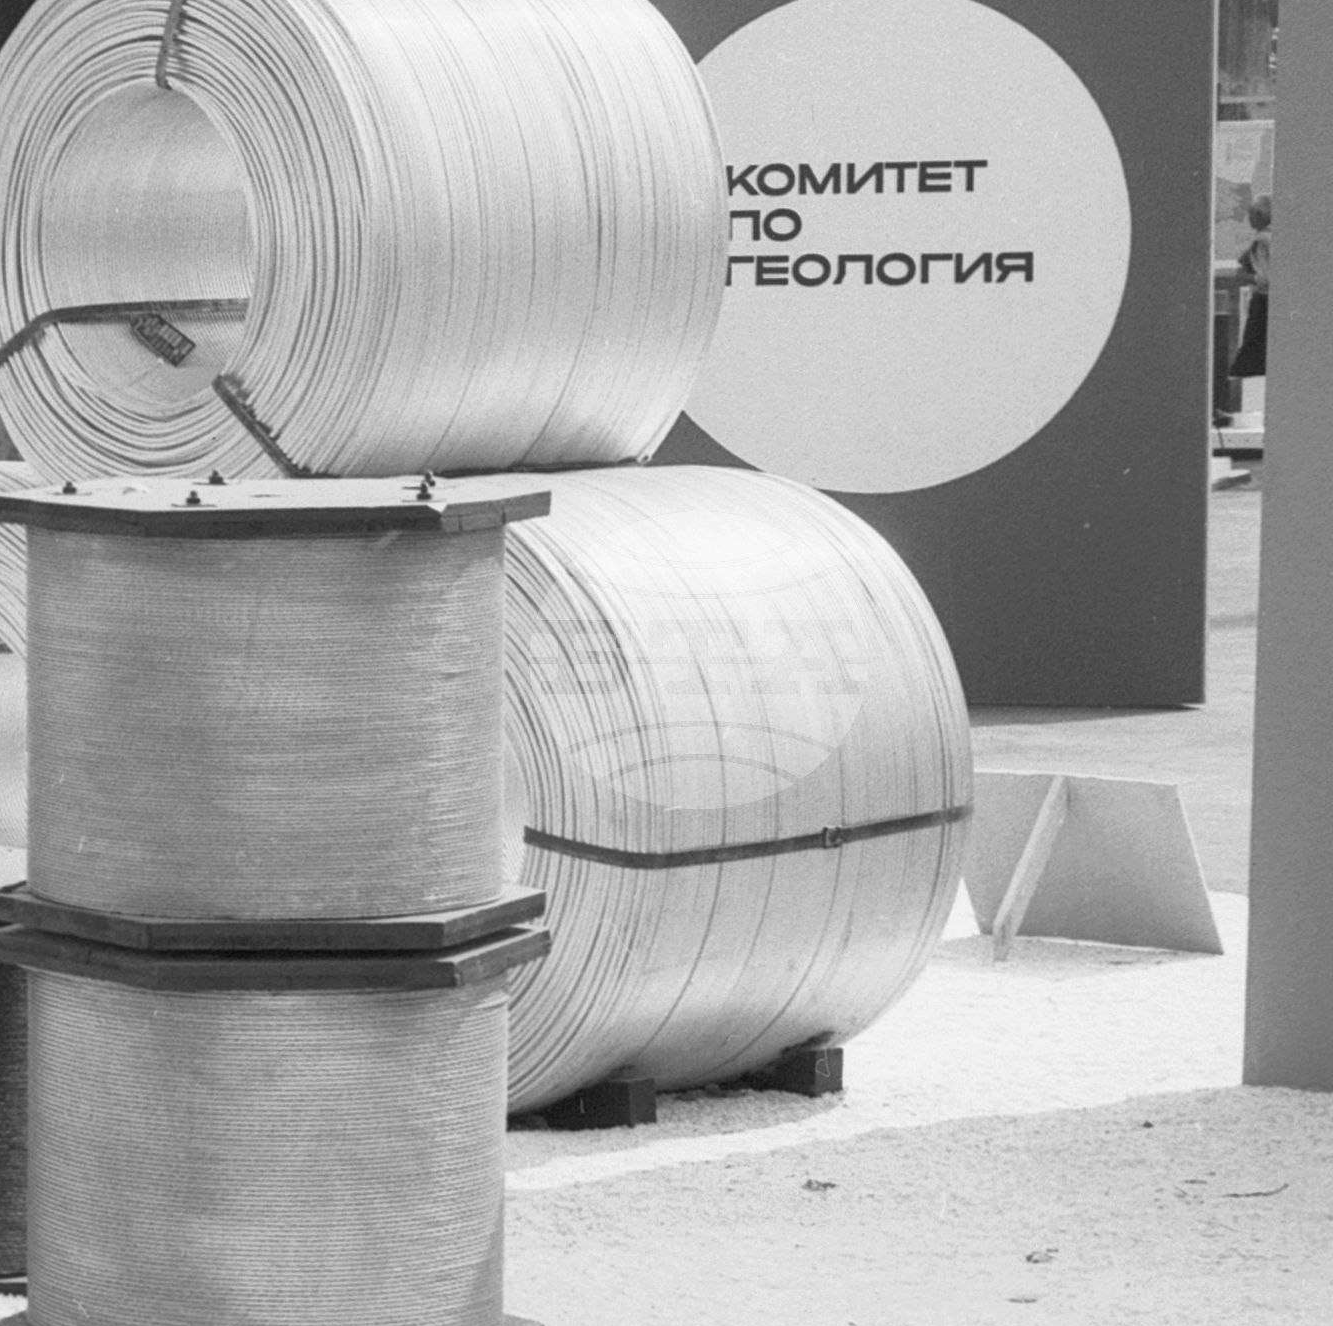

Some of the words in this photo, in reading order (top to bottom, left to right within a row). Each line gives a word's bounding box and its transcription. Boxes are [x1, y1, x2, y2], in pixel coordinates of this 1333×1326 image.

[726, 159, 988, 196] КОМИТЕТ
[729, 208, 802, 241] ПО
[725, 251, 1034, 287] ГЕОЛОГИЯ
